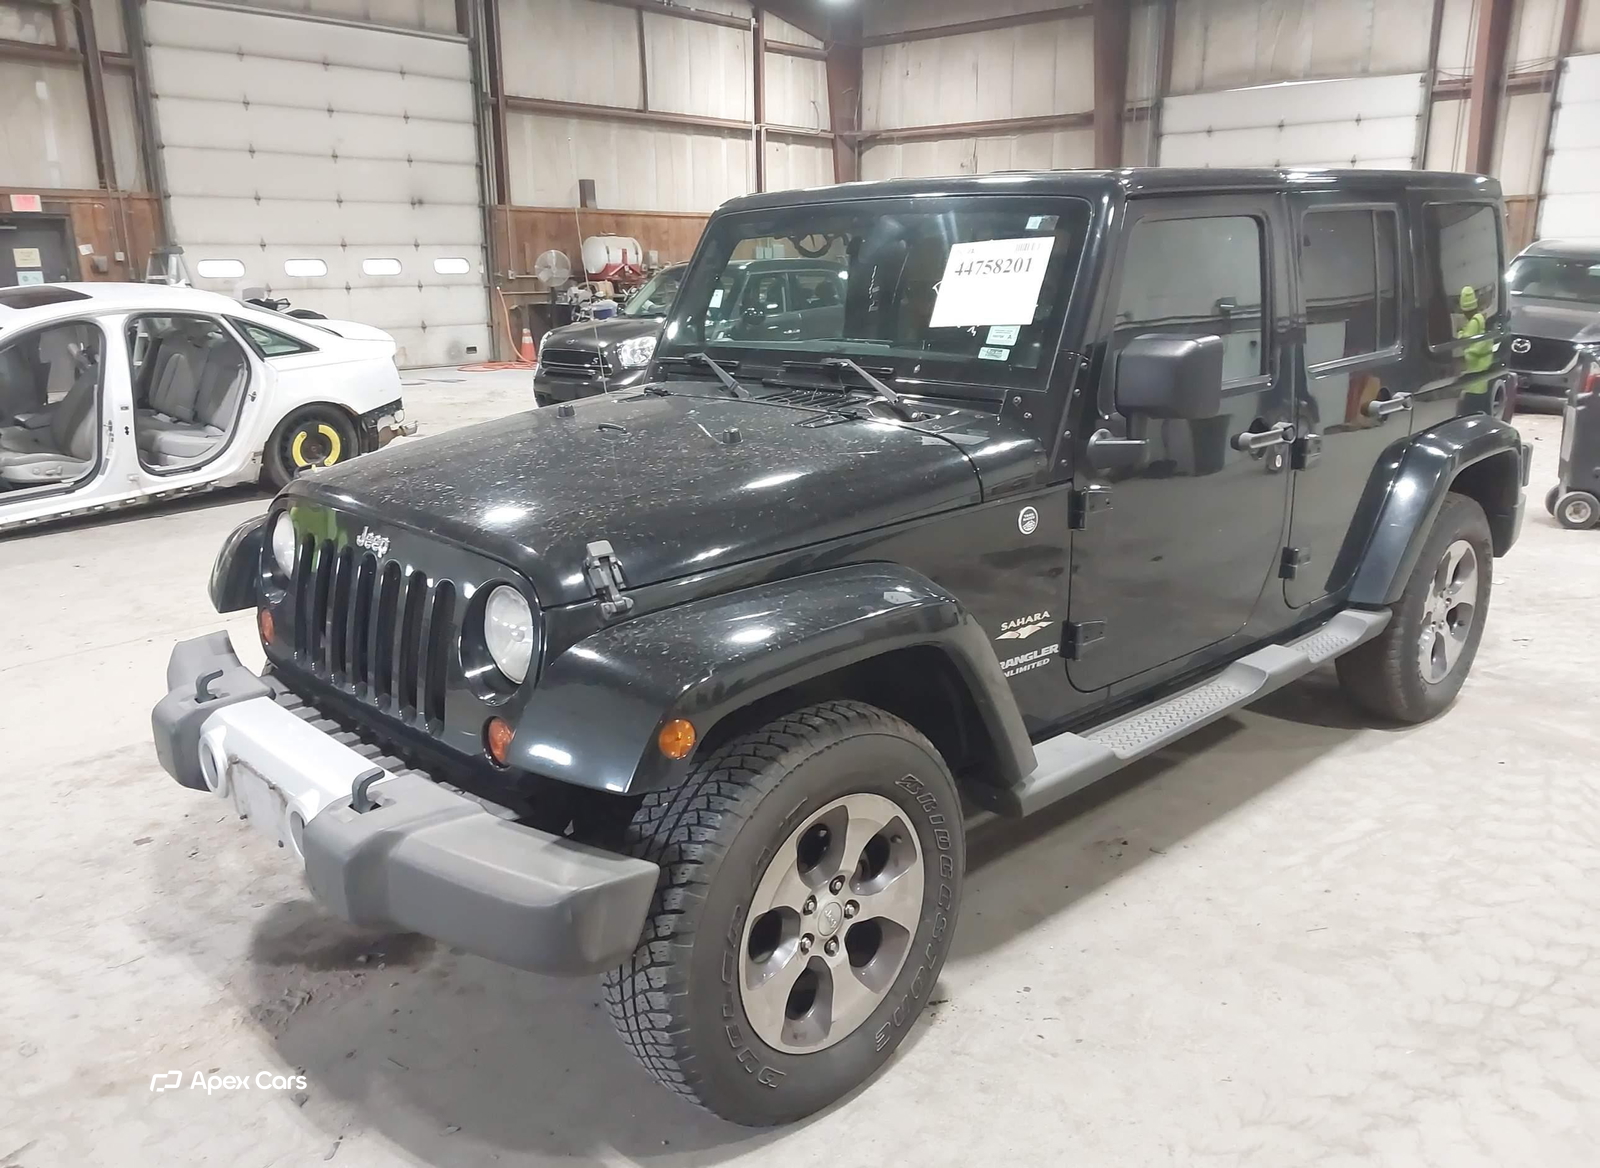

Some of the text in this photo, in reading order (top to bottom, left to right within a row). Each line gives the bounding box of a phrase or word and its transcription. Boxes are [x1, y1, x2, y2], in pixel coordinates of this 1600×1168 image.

[954, 257, 1033, 276] 44758201
[356, 525, 391, 559] Jeep
[1000, 610, 1051, 632] SAHARA
[999, 643, 1060, 670] RANGLER
[1003, 657, 1051, 678] NLIMITED
[874, 772, 955, 1052] BRIDGESTONE
